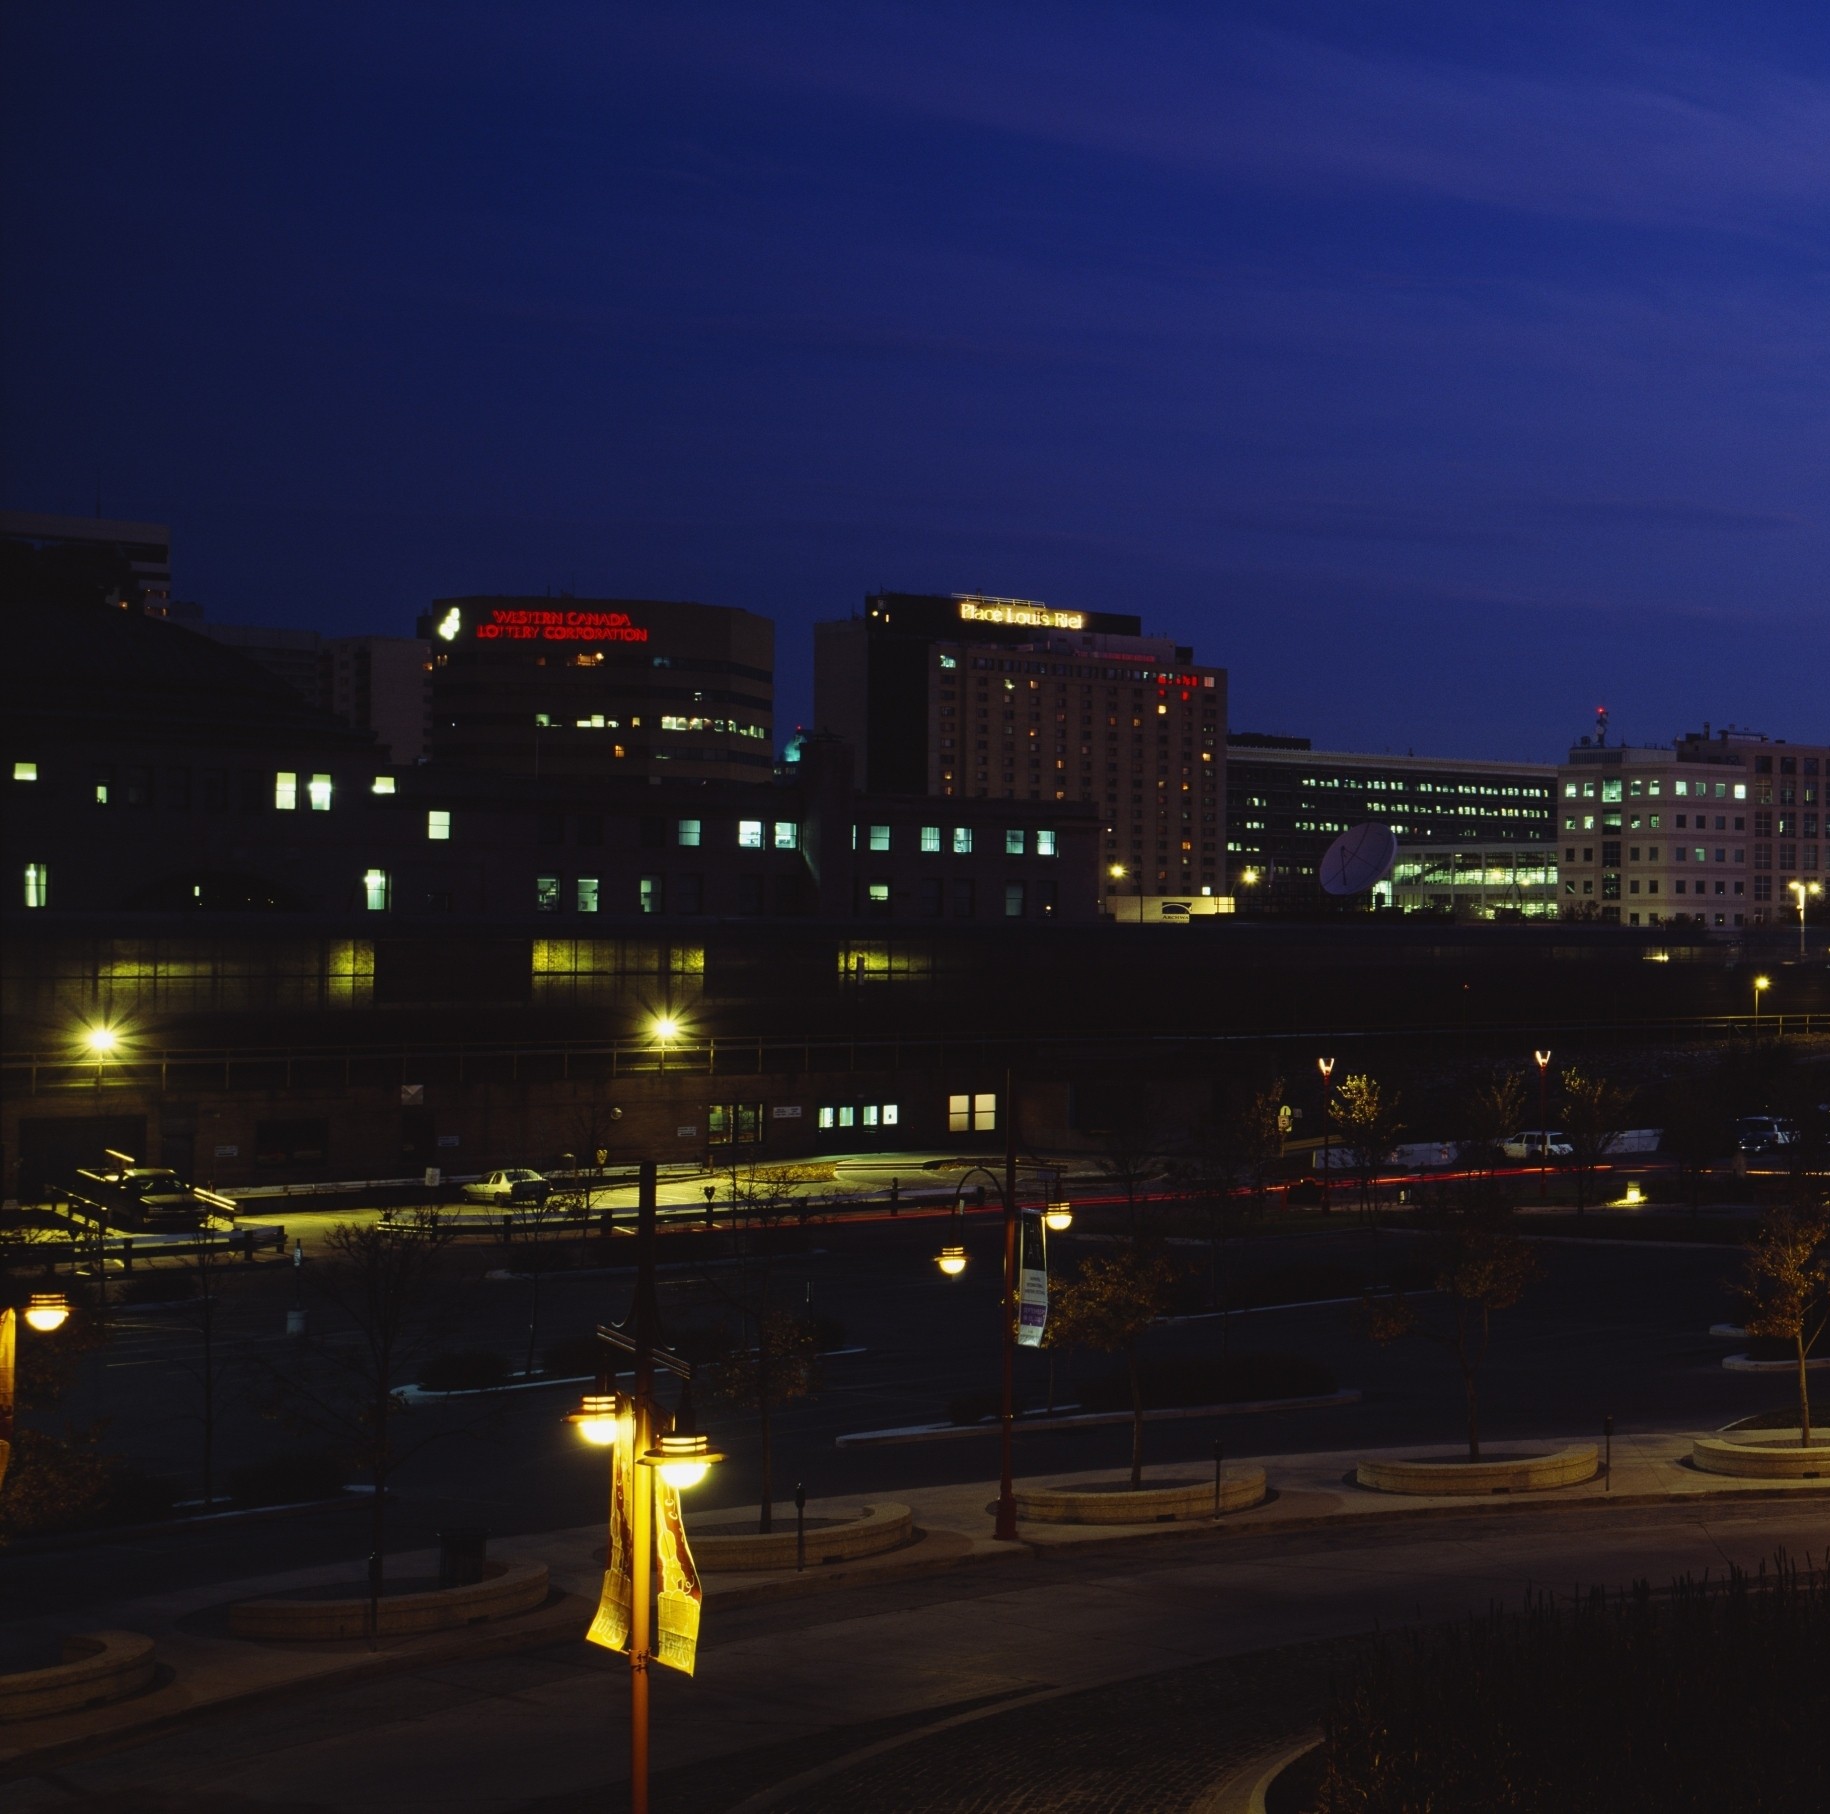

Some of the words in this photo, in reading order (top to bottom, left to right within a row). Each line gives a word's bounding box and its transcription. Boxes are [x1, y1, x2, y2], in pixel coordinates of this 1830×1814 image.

[493, 610, 563, 624] WESTERN
[567, 612, 631, 626] CANADA
[960, 603, 1003, 622] Place
[1006, 607, 1049, 626] Louis
[1054, 612, 1082, 629] Riel
[477, 624, 539, 638] LOTTERY
[543, 625, 648, 641] CORPORATION
